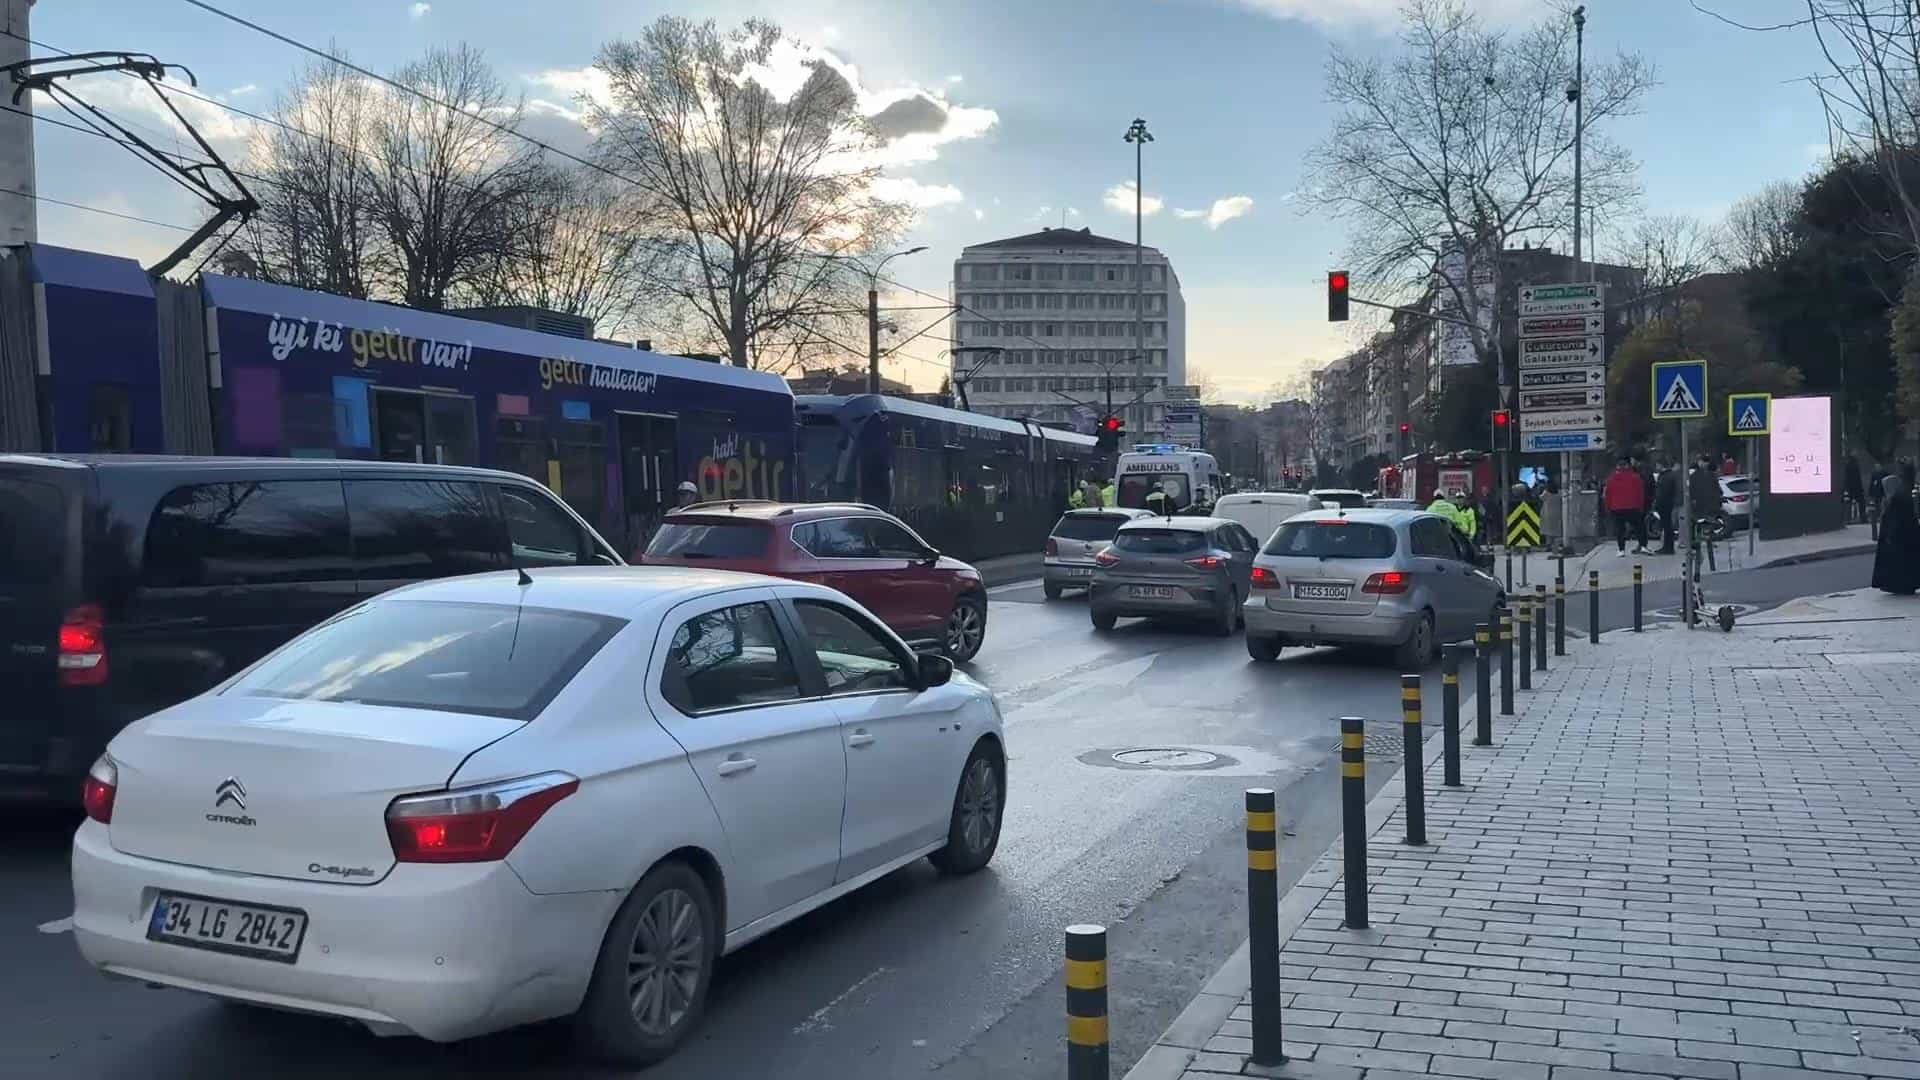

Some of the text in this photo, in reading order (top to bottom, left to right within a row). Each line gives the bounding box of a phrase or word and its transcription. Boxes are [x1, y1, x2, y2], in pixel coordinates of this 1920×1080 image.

[268, 312, 473, 370] iyi ki getir var!
[540, 355, 657, 393] getir halleder!
[1524, 353, 1586, 365] Galatasaray
[713, 432, 738, 460] hah!
[1126, 463, 1180, 473] AMBULANS
[165, 902, 295, 949] 34 LG 2842
